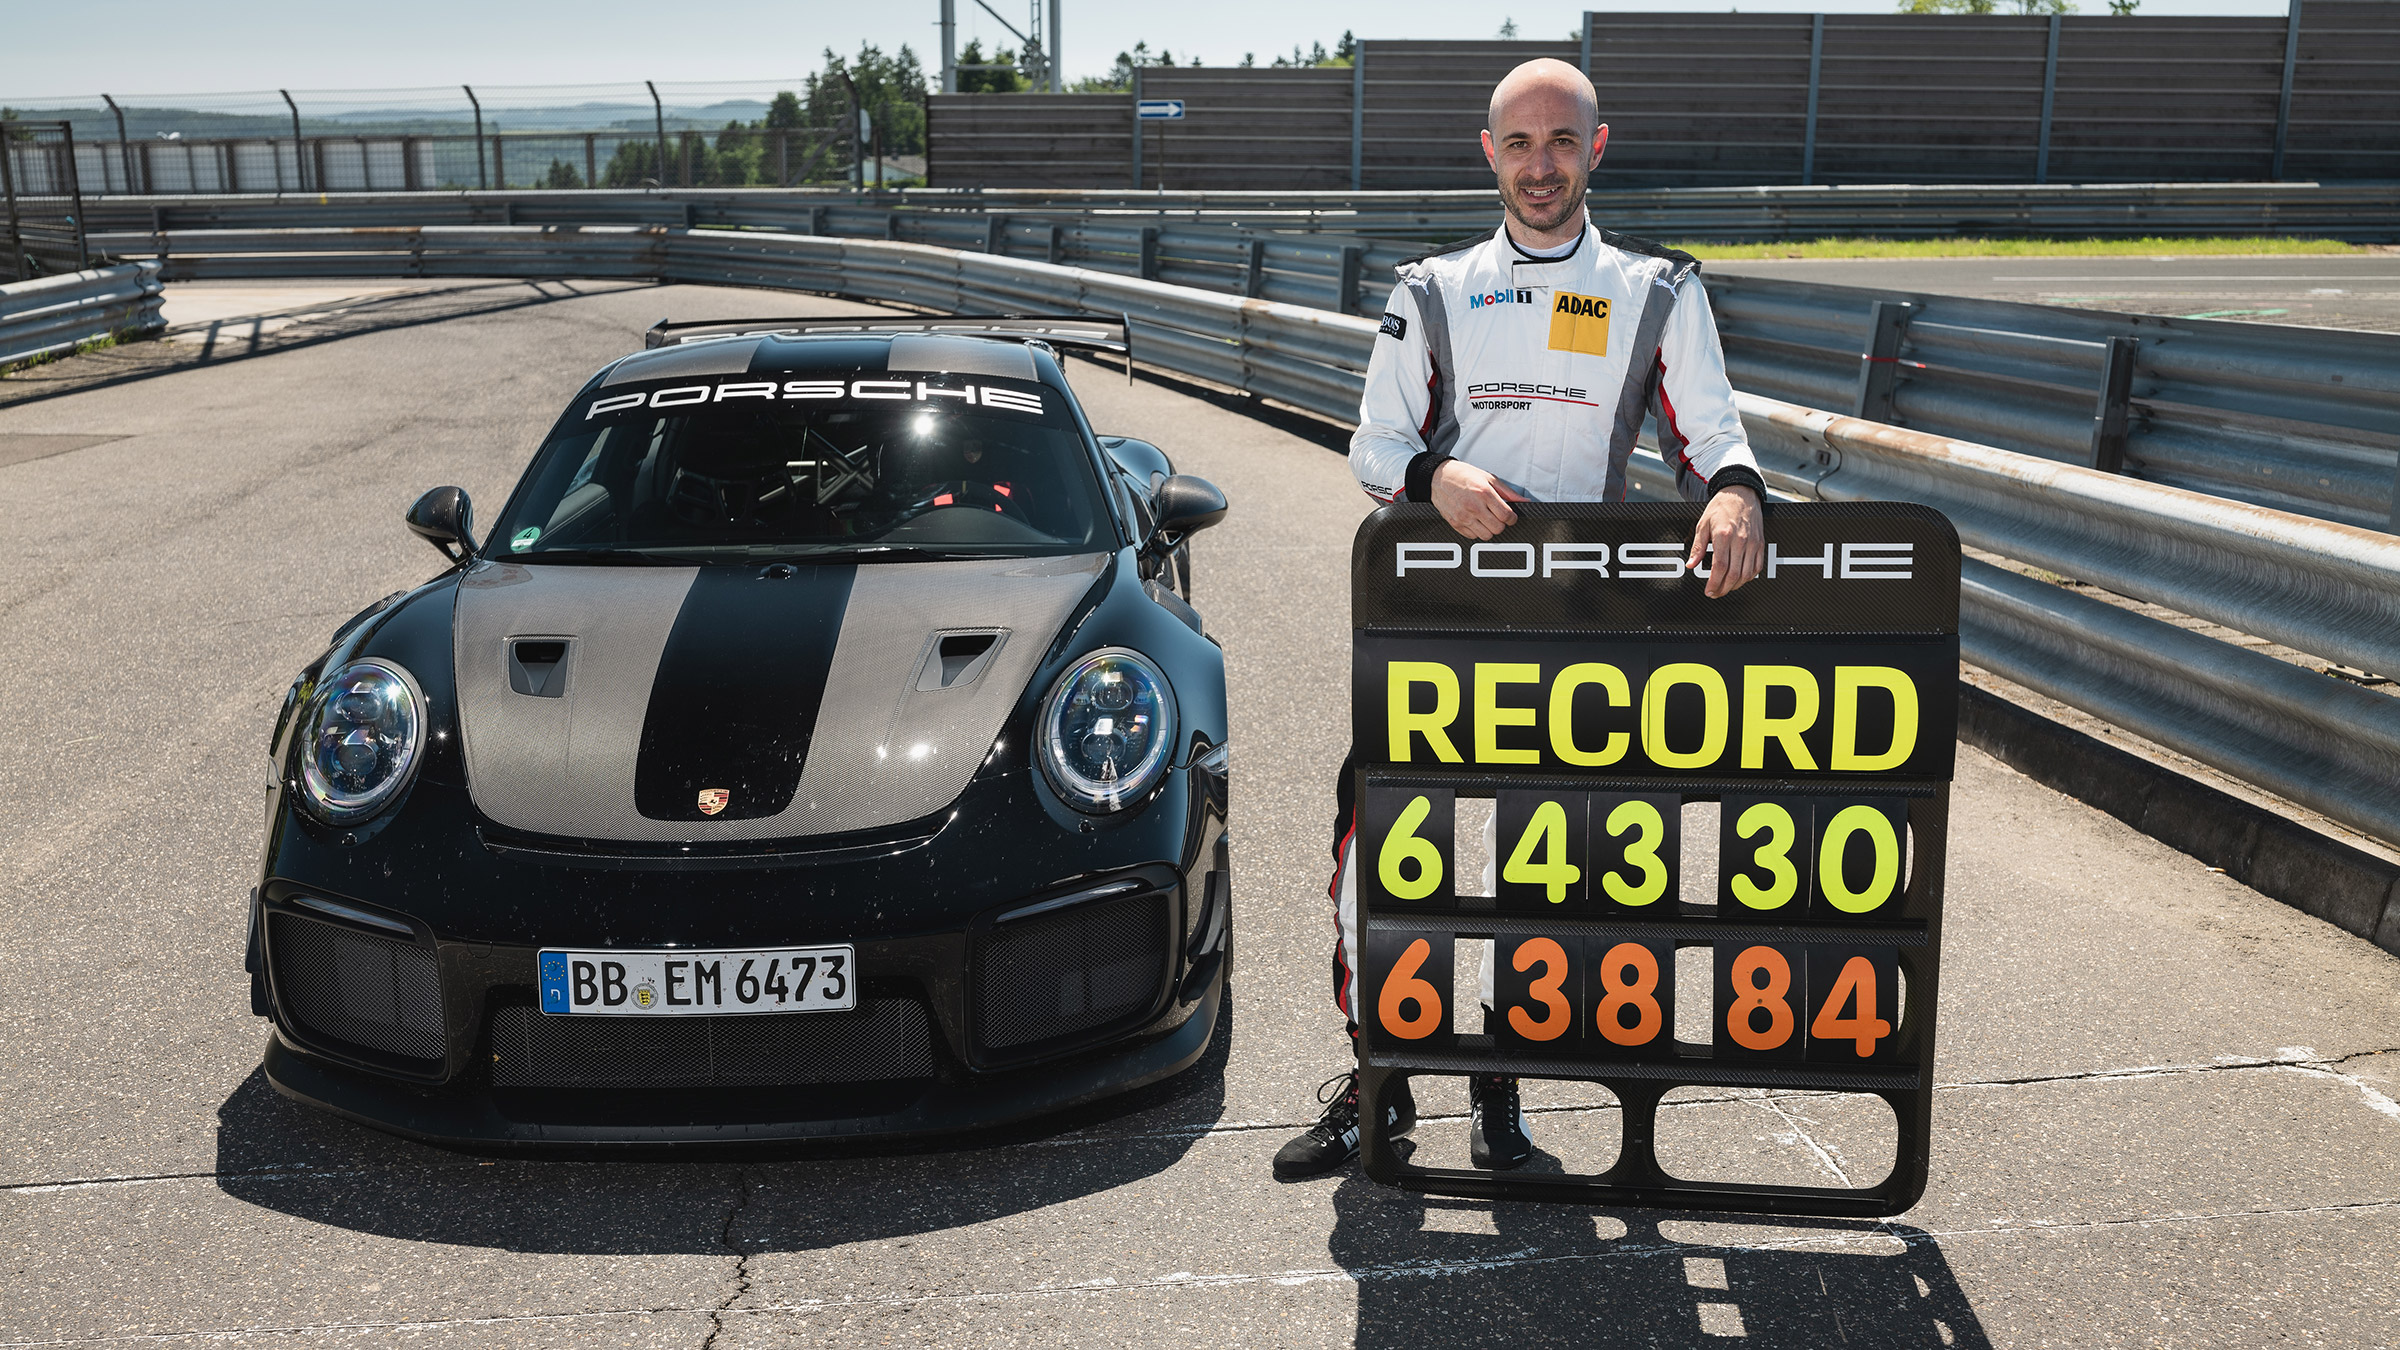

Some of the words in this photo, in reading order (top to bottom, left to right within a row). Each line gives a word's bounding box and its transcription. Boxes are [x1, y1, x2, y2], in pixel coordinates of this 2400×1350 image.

[1470, 289, 1514, 309] Mobil
[1556, 295, 1608, 319] ADAC
[585, 381, 1044, 421] PORSCHE
[1468, 382, 1587, 399] PORSCHE
[1471, 401, 1532, 411] MOTORSPORT
[1387, 660, 1919, 772] RECORD
[1378, 796, 1443, 900] 6
[572, 961, 628, 1006] BB
[664, 960, 722, 1006] EM
[735, 955, 846, 1005] 6473
[1378, 938, 1442, 1040] 6
